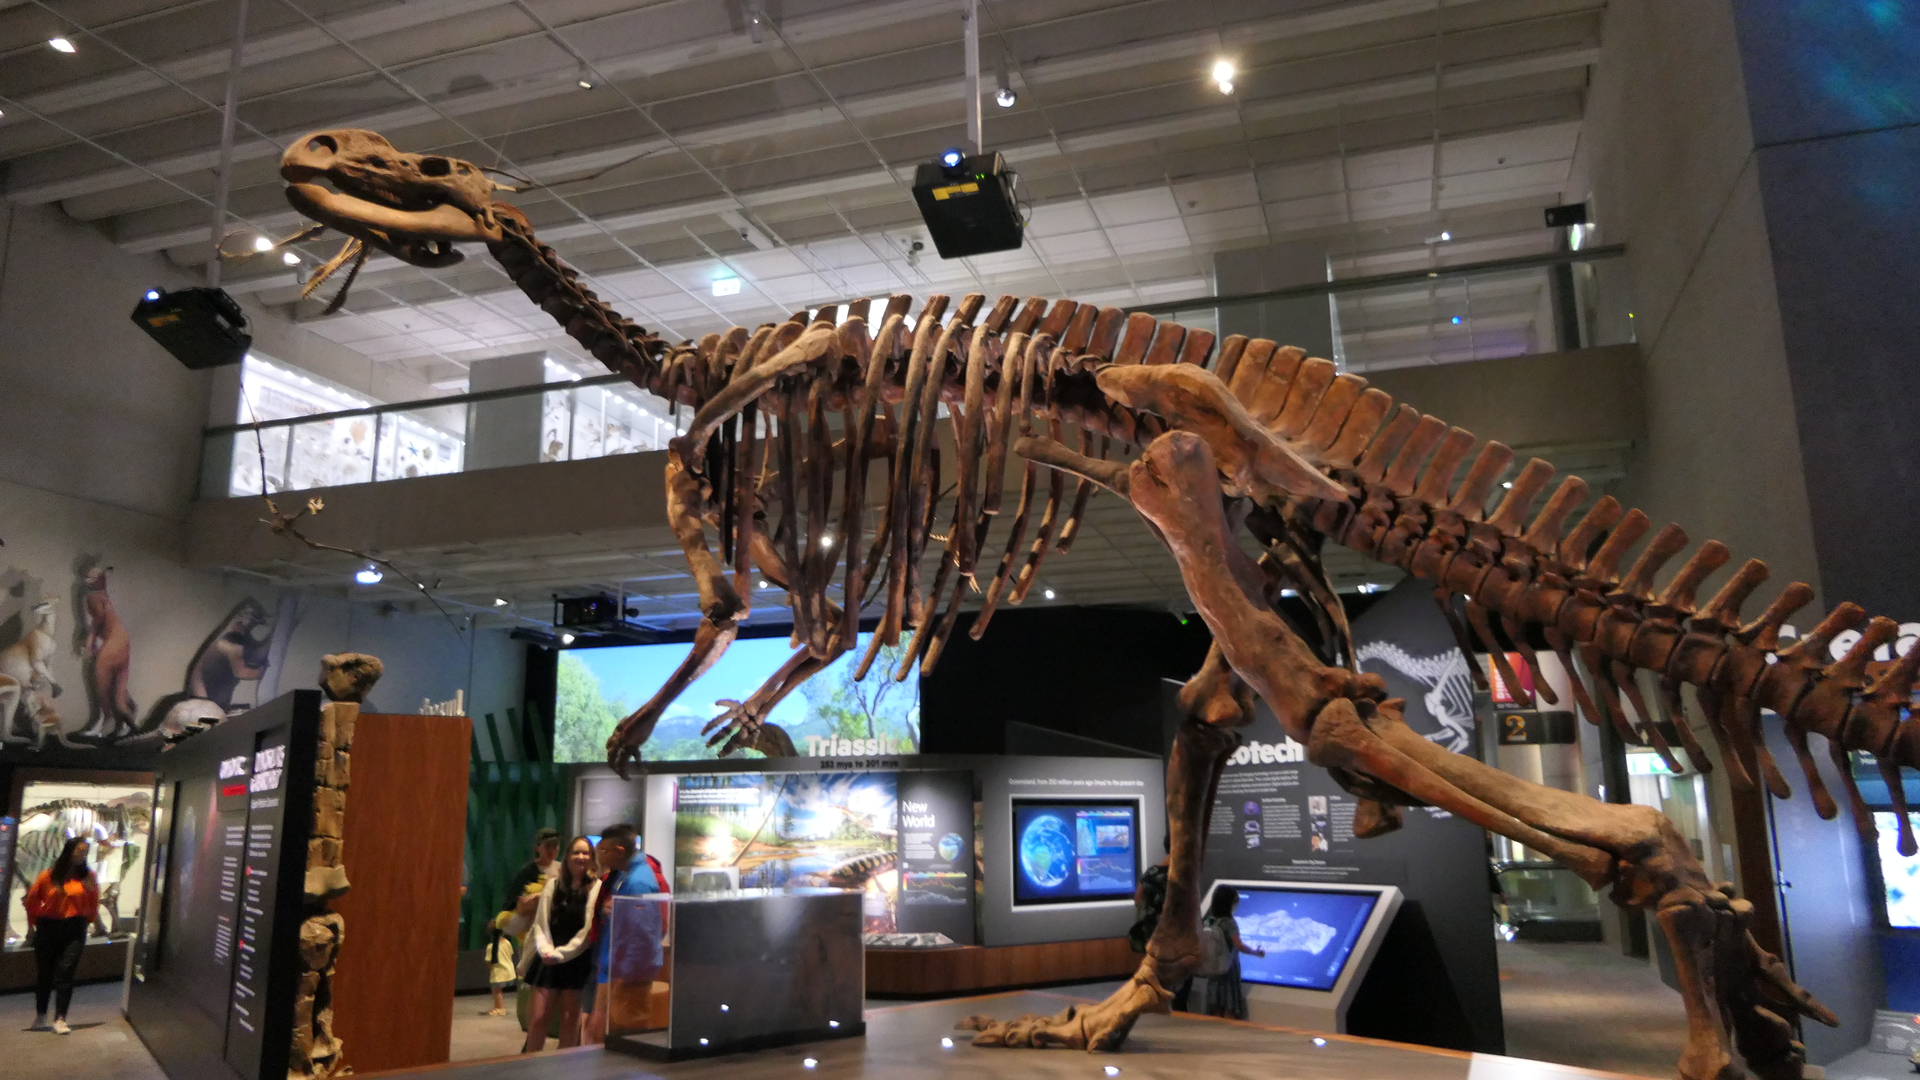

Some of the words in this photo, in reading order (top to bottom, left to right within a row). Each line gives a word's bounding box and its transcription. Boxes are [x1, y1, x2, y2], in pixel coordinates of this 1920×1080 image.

[1505, 715, 1527, 741] 2
[805, 732, 899, 757] Triassic
[1226, 735, 1304, 766] otech
[902, 801, 928, 813] New
[902, 814, 935, 828] World
